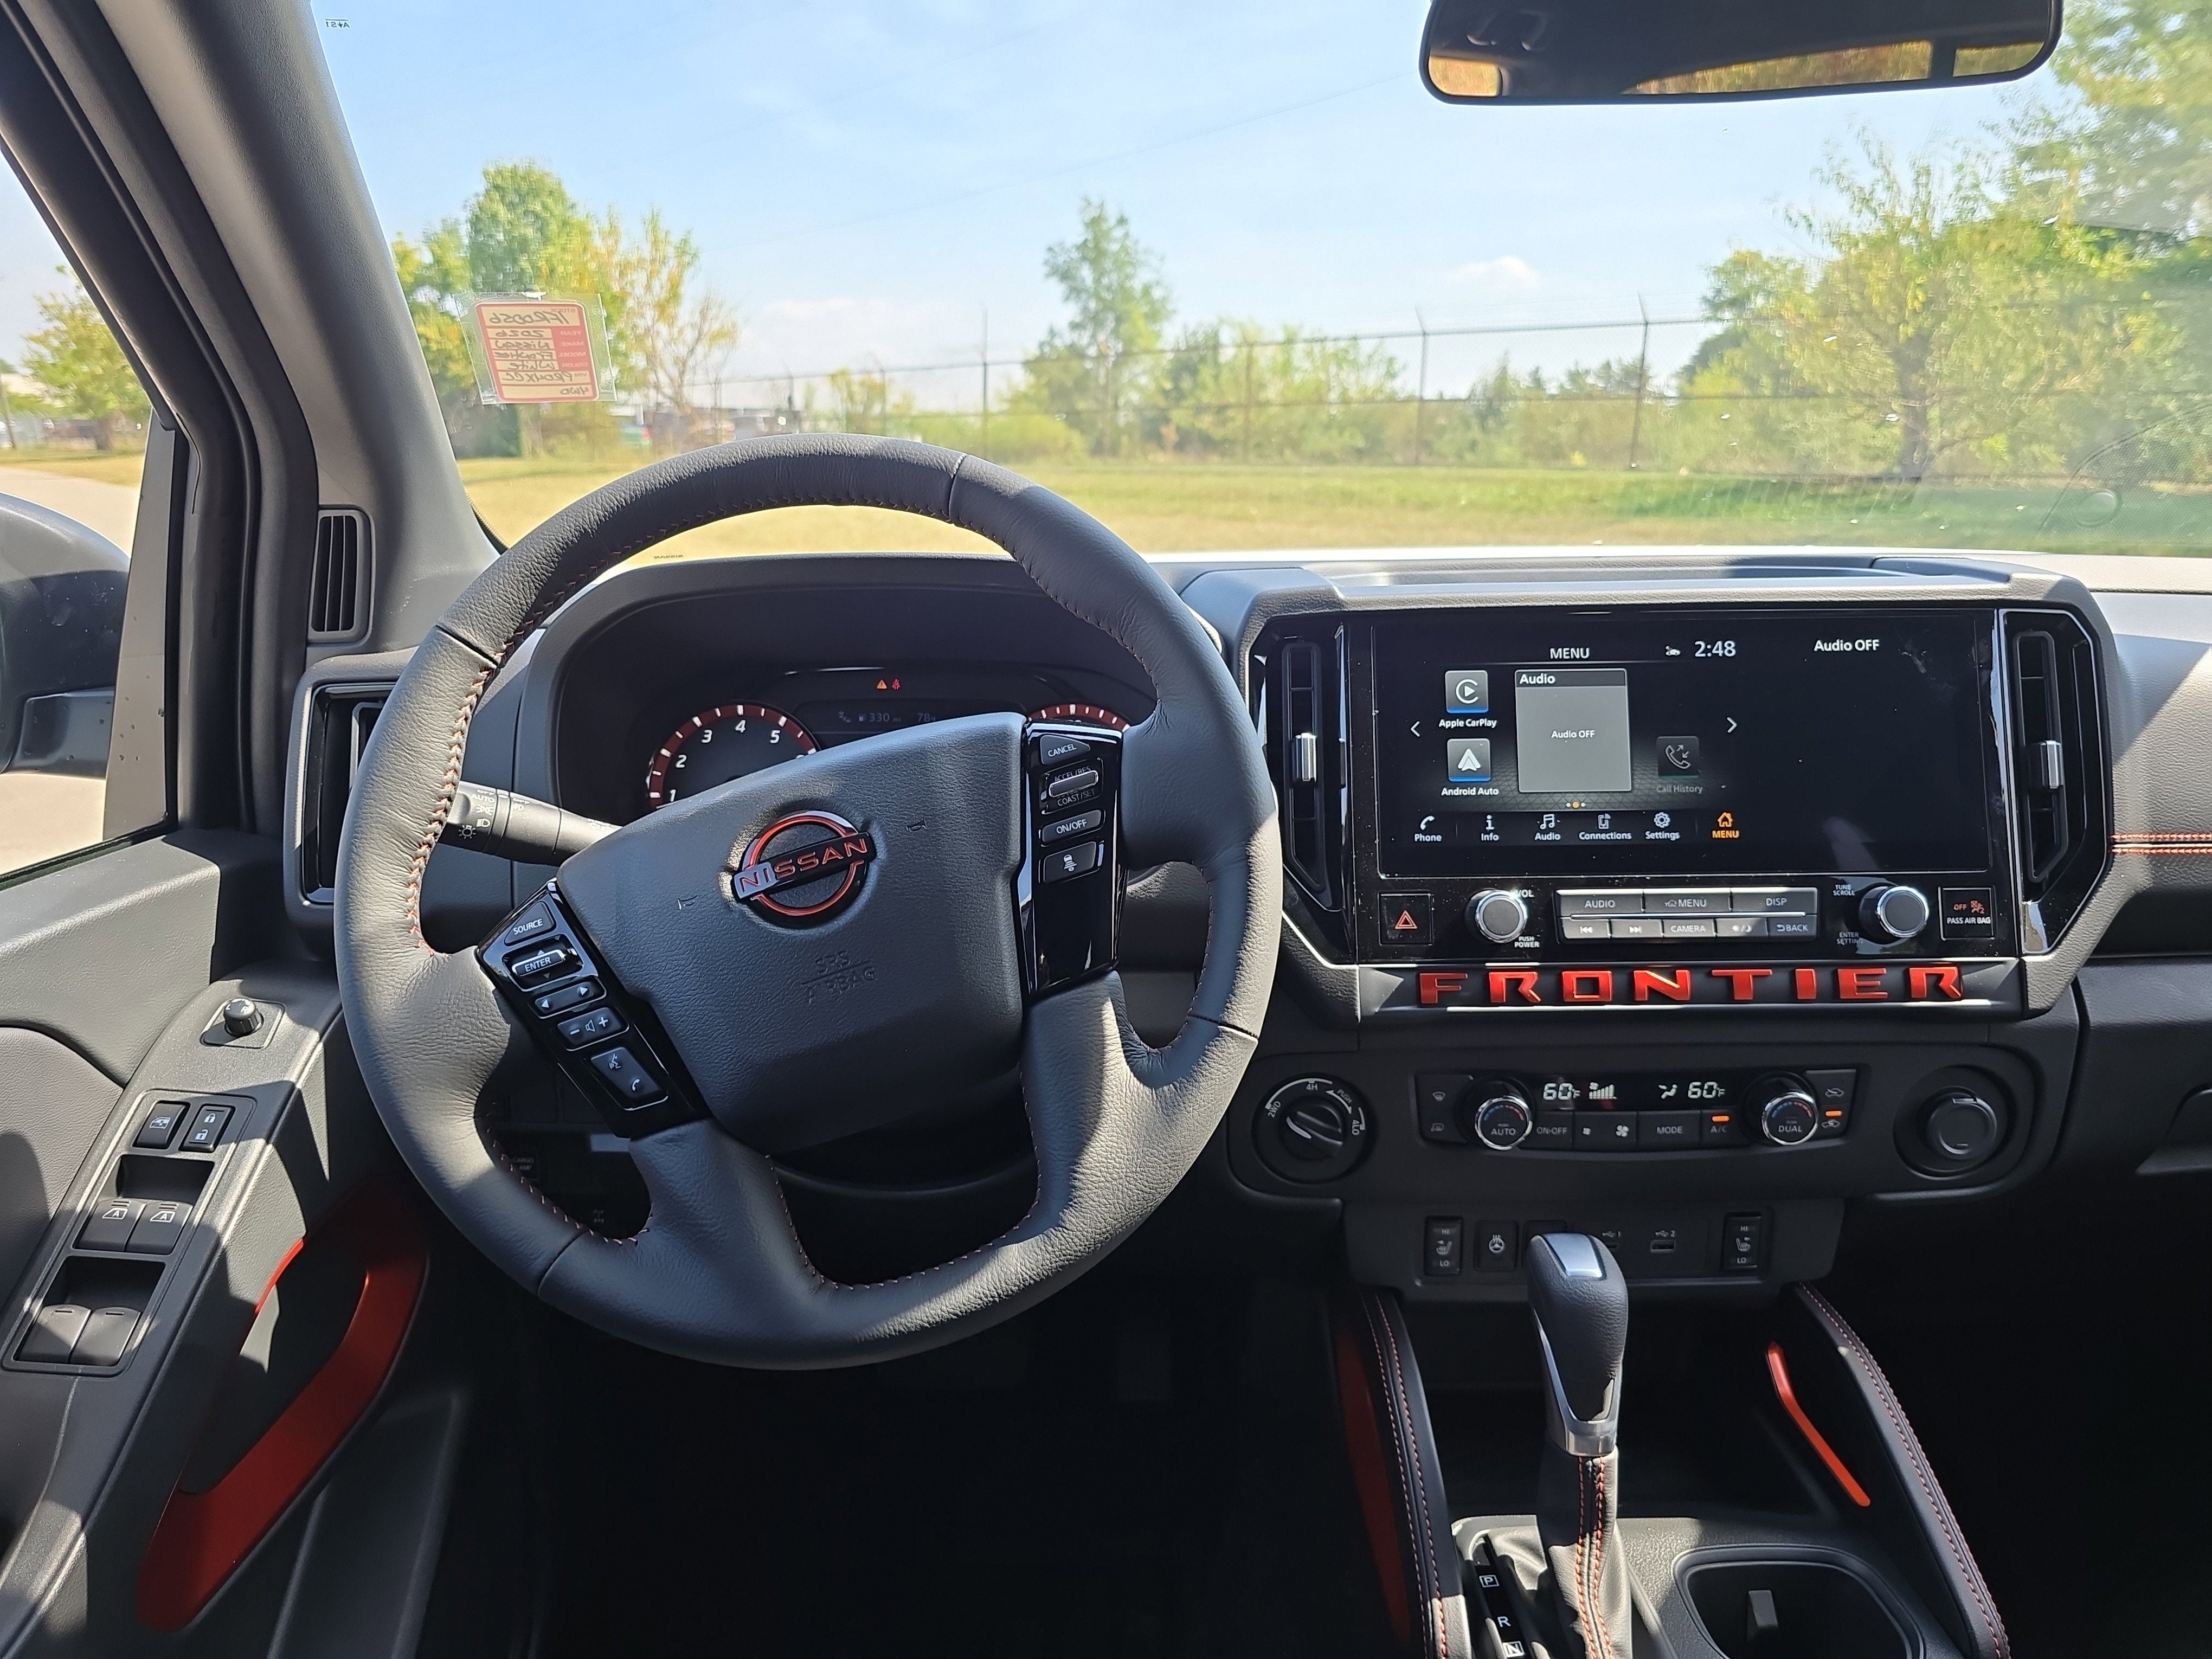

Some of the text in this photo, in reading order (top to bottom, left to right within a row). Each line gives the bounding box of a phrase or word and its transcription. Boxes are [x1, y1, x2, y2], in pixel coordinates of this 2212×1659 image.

[1694, 641, 1736, 657] 2:48
[1814, 639, 1879, 652] Audio OFF
[1549, 648, 1590, 659] MENU
[1519, 674, 1555, 684] Audio
[870, 713, 890, 722] 330
[735, 719, 746, 733] 4
[1439, 719, 1497, 728] Apple CarPlay
[701, 730, 713, 743] 3
[770, 730, 781, 743] 5
[1551, 730, 1595, 738] Audio OFF
[1048, 743, 1077, 757] CANCEL
[676, 755, 687, 768] 2
[1441, 787, 1499, 796] Android Auto
[1674, 785, 1703, 794] History
[471, 793, 496, 803] AUTO
[670, 789, 676, 802] 1
[1057, 789, 1096, 807] COAST/SET
[1056, 819, 1087, 834] ON/OFF
[1414, 833, 1442, 842] Phone
[1481, 833, 1499, 841] Info
[1534, 832, 1561, 841] Audio
[1579, 832, 1632, 840] Connections
[1645, 831, 1680, 841] Settings
[1712, 830, 1739, 839] MENU
[740, 838, 867, 892] NISSAN
[1516, 890, 1534, 898] VOL
[1585, 899, 1615, 908] AUDIO
[1678, 898, 1707, 908] MENU
[1766, 897, 1787, 906] DISP
[513, 918, 543, 936] SOURCE
[1670, 924, 1706, 933] CAMERA
[1786, 923, 1808, 933] BACK
[525, 956, 551, 973] ENTER
[1419, 966, 1962, 1004] FRONTIER
[240, 1006, 248, 1015] R
[1337, 1089, 1353, 1103] PUSH
[1268, 1101, 1281, 1118] 2WD
[1352, 1120, 1360, 1135] 4LO
[1490, 1127, 1516, 1136] AUTO
[1656, 1126, 1683, 1134] MODE
[1711, 1125, 1727, 1134] A/C
[1778, 1125, 1802, 1133] DUAL
[1483, 1577, 1494, 1585] P
[1497, 1616, 1511, 1627] R
[1508, 1643, 1520, 1654] N
